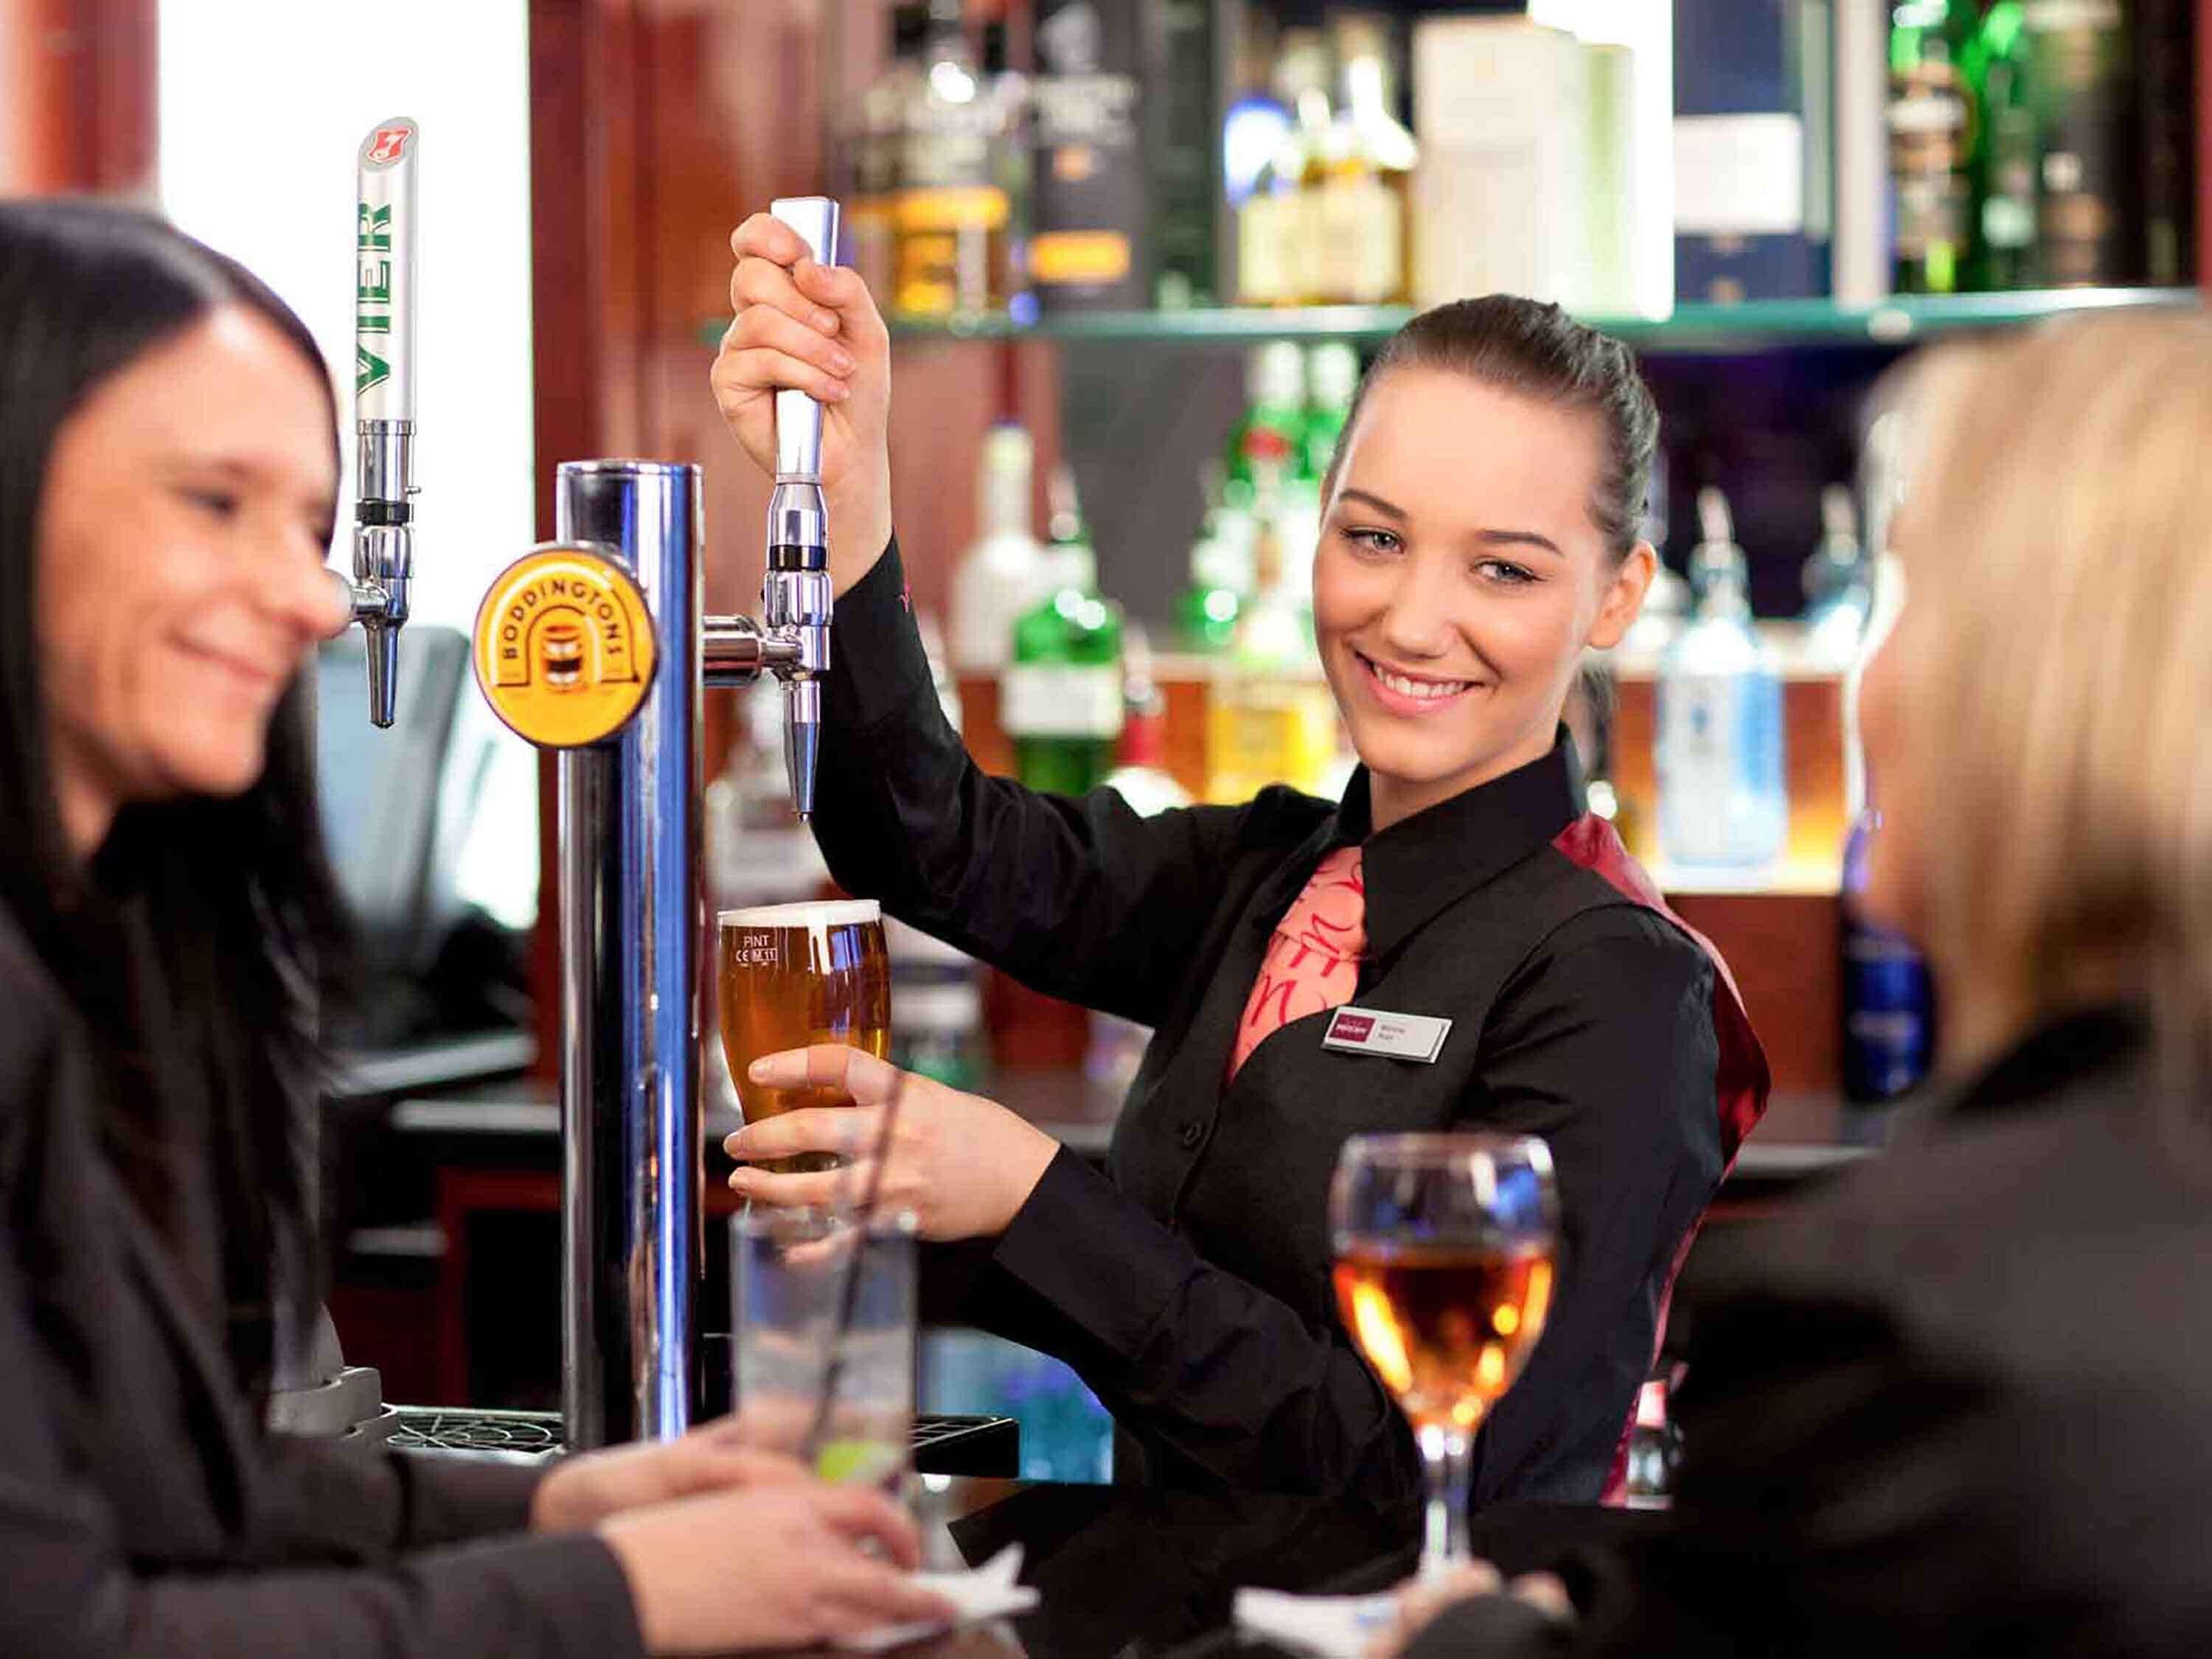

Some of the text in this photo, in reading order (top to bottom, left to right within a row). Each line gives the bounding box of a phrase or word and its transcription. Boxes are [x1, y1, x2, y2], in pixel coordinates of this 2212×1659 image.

[357, 203, 391, 397] VIER
[502, 579, 622, 660] BODDINGTONS
[743, 934, 769, 947] PINT
